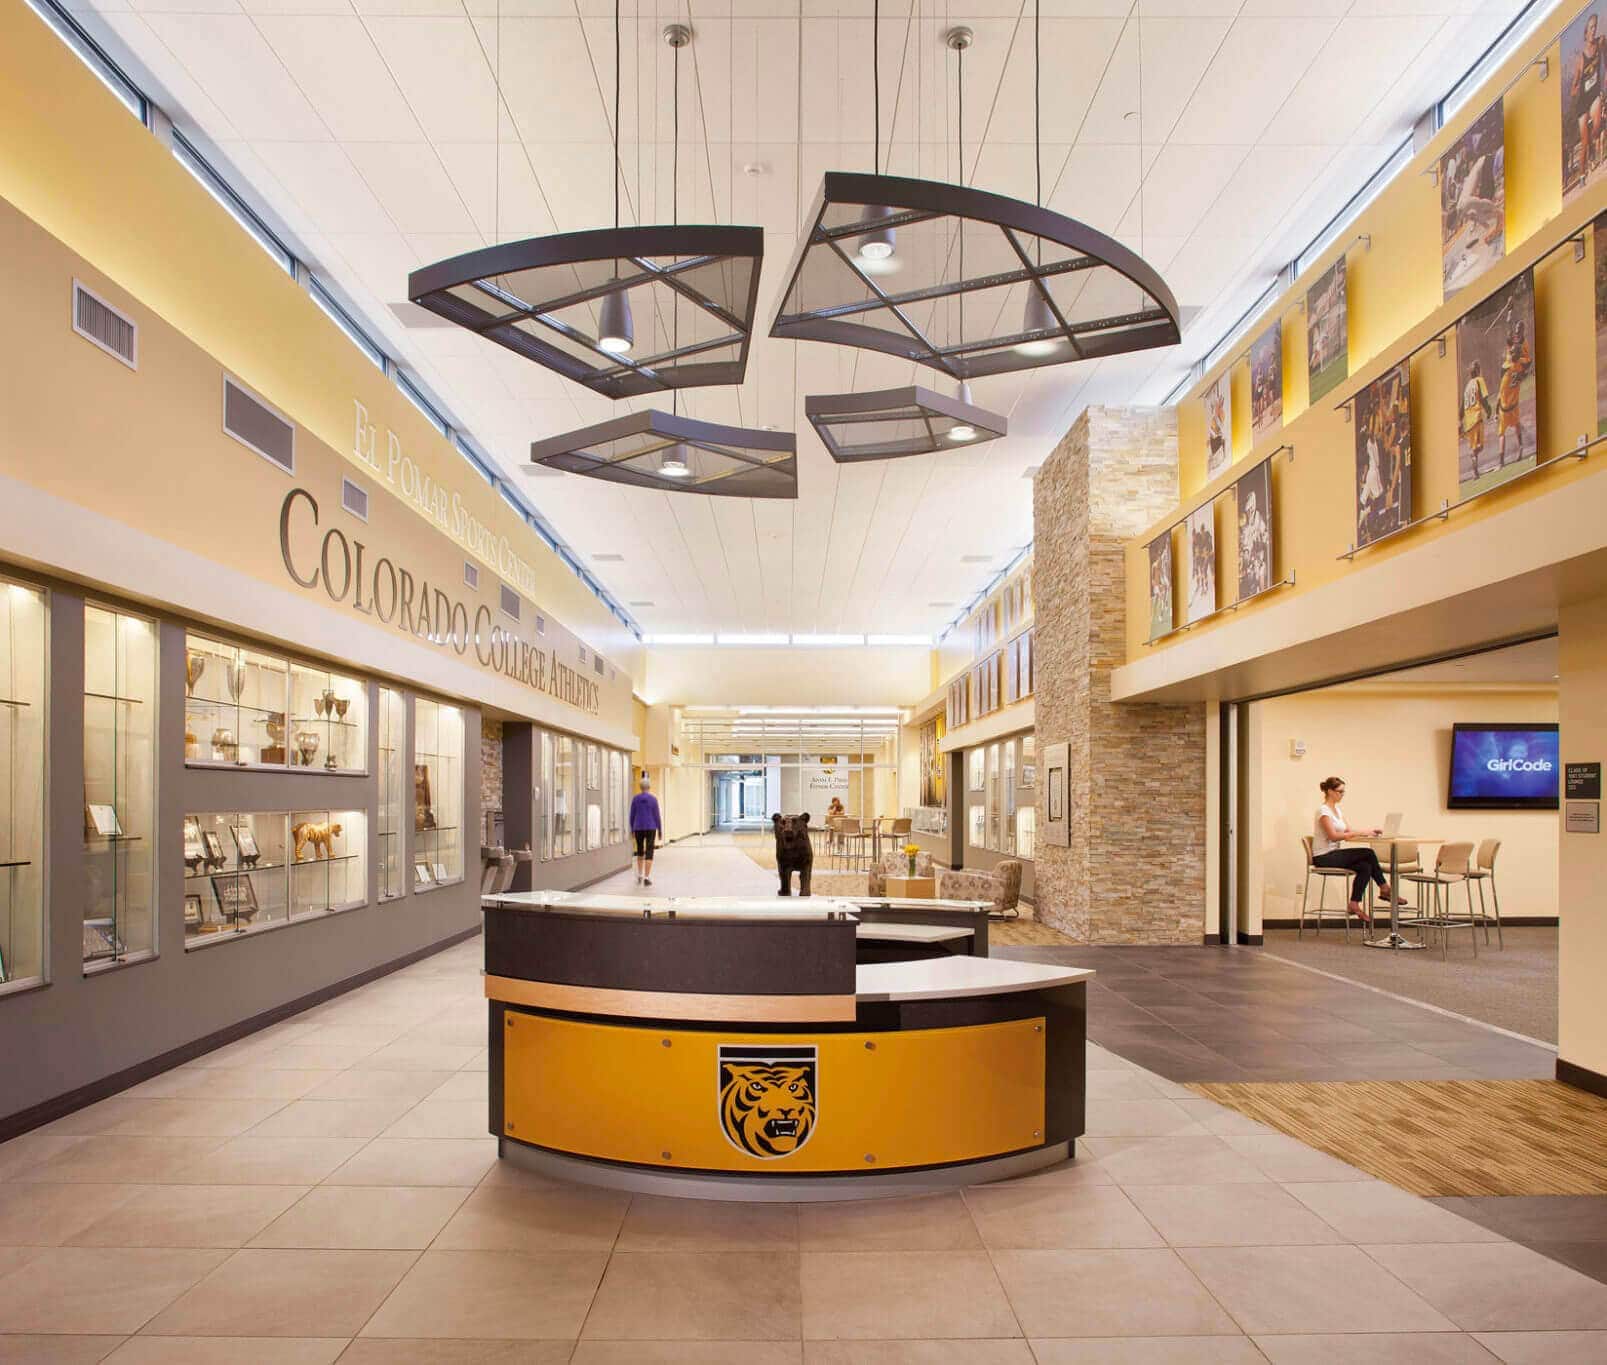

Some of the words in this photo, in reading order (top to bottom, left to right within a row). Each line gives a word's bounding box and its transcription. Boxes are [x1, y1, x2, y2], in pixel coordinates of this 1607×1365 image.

[280, 487, 468, 655] COLORADO
[474, 604, 546, 692] COLLEGE
[548, 649, 599, 715] ATHLETICS
[1487, 759, 1552, 772] GirlCode
